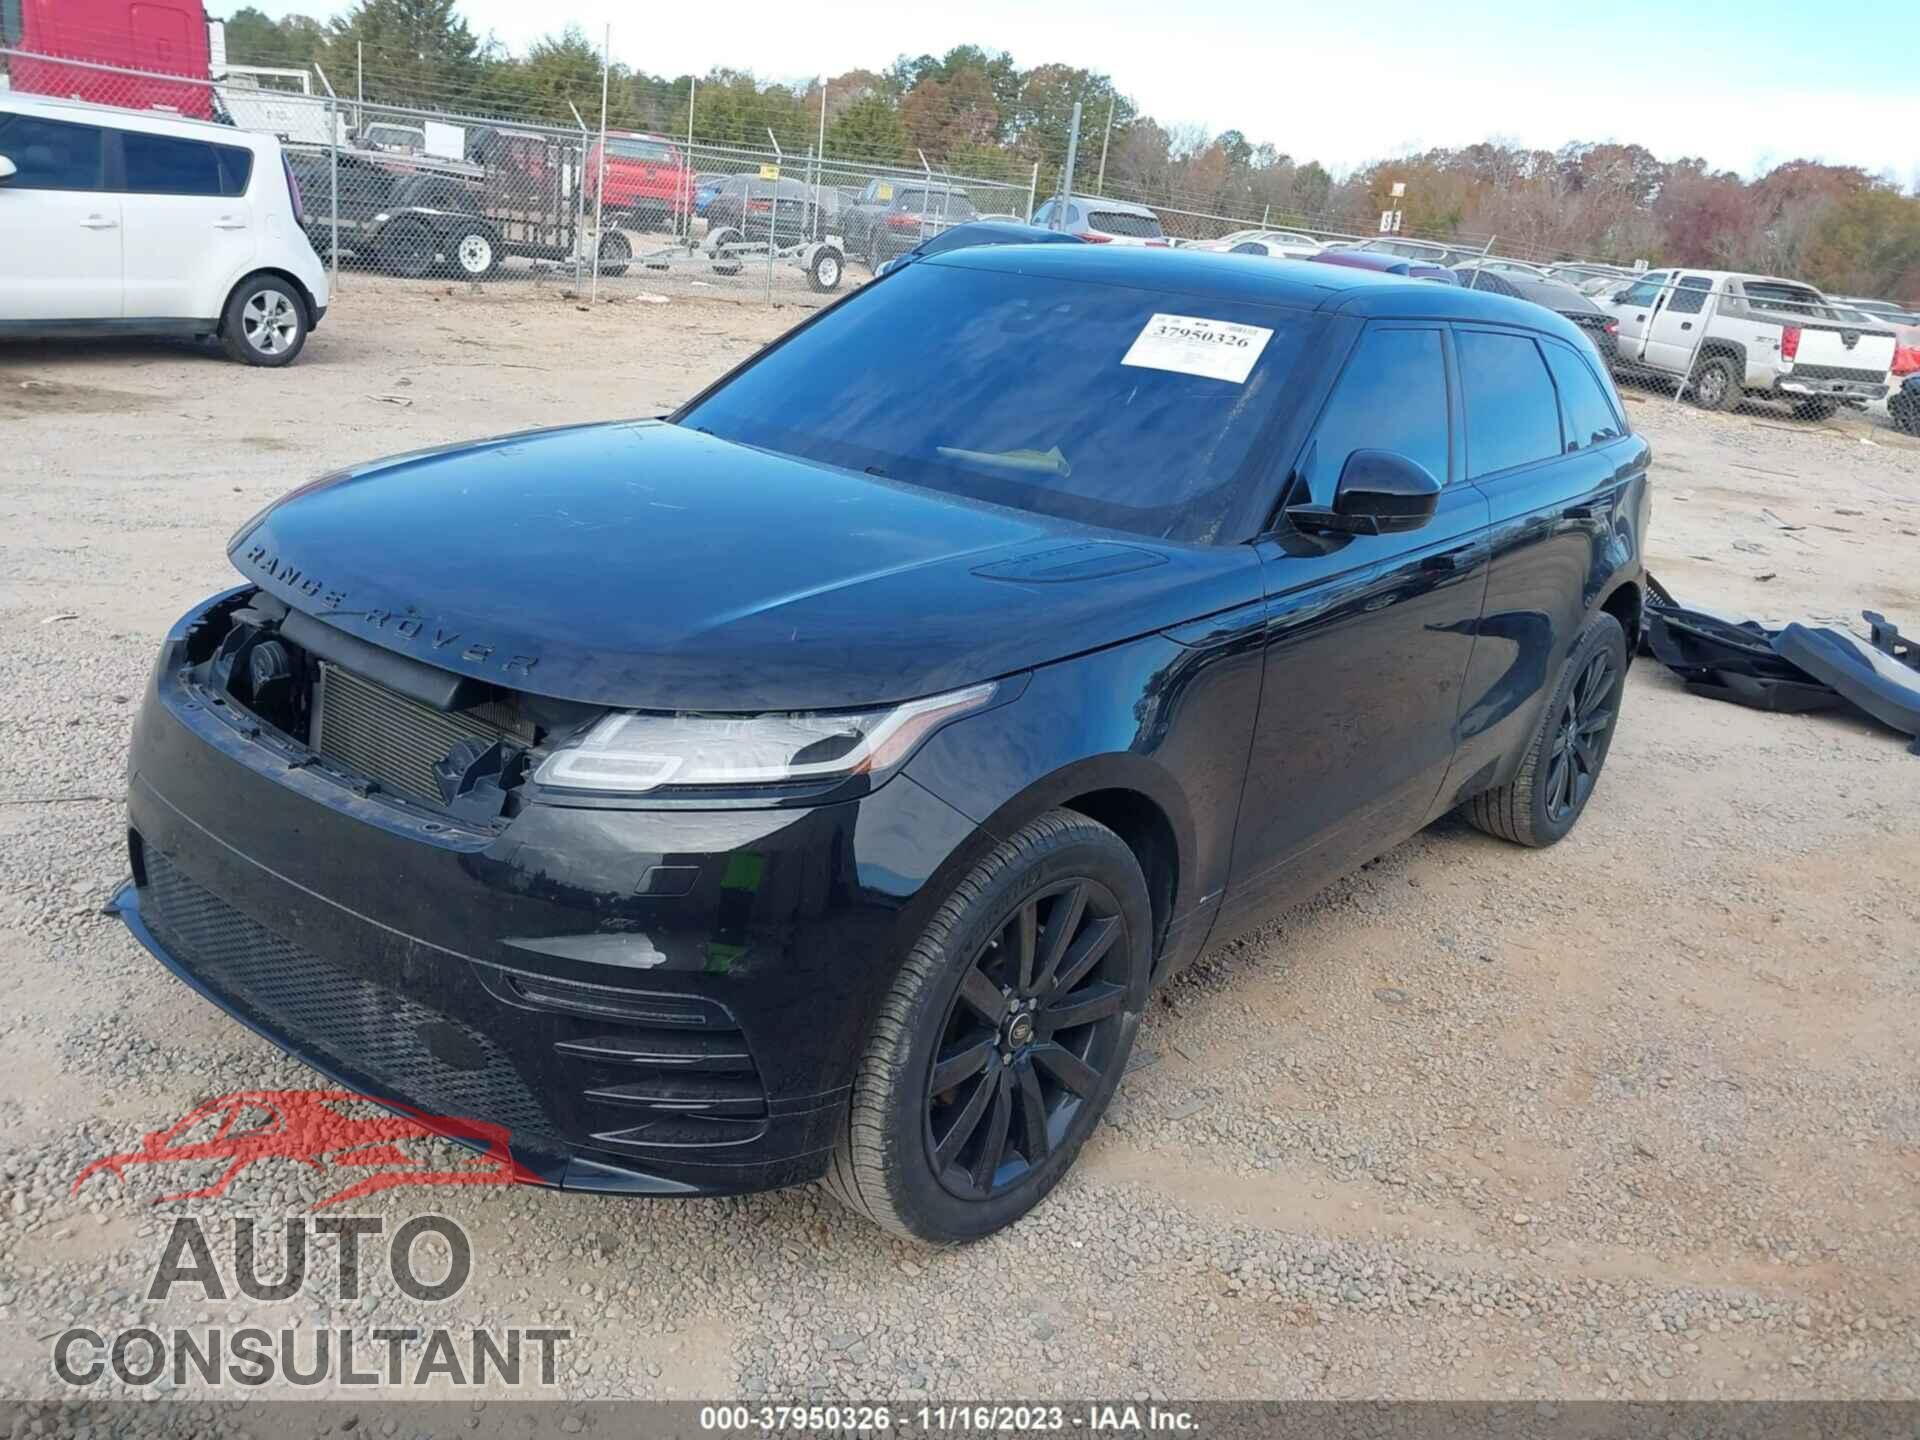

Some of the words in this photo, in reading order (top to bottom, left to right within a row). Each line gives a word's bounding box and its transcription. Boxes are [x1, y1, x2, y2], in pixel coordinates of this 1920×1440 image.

[1153, 325, 1249, 348] 37950326
[247, 545, 347, 609] RANGE
[364, 607, 539, 676] ROVER
